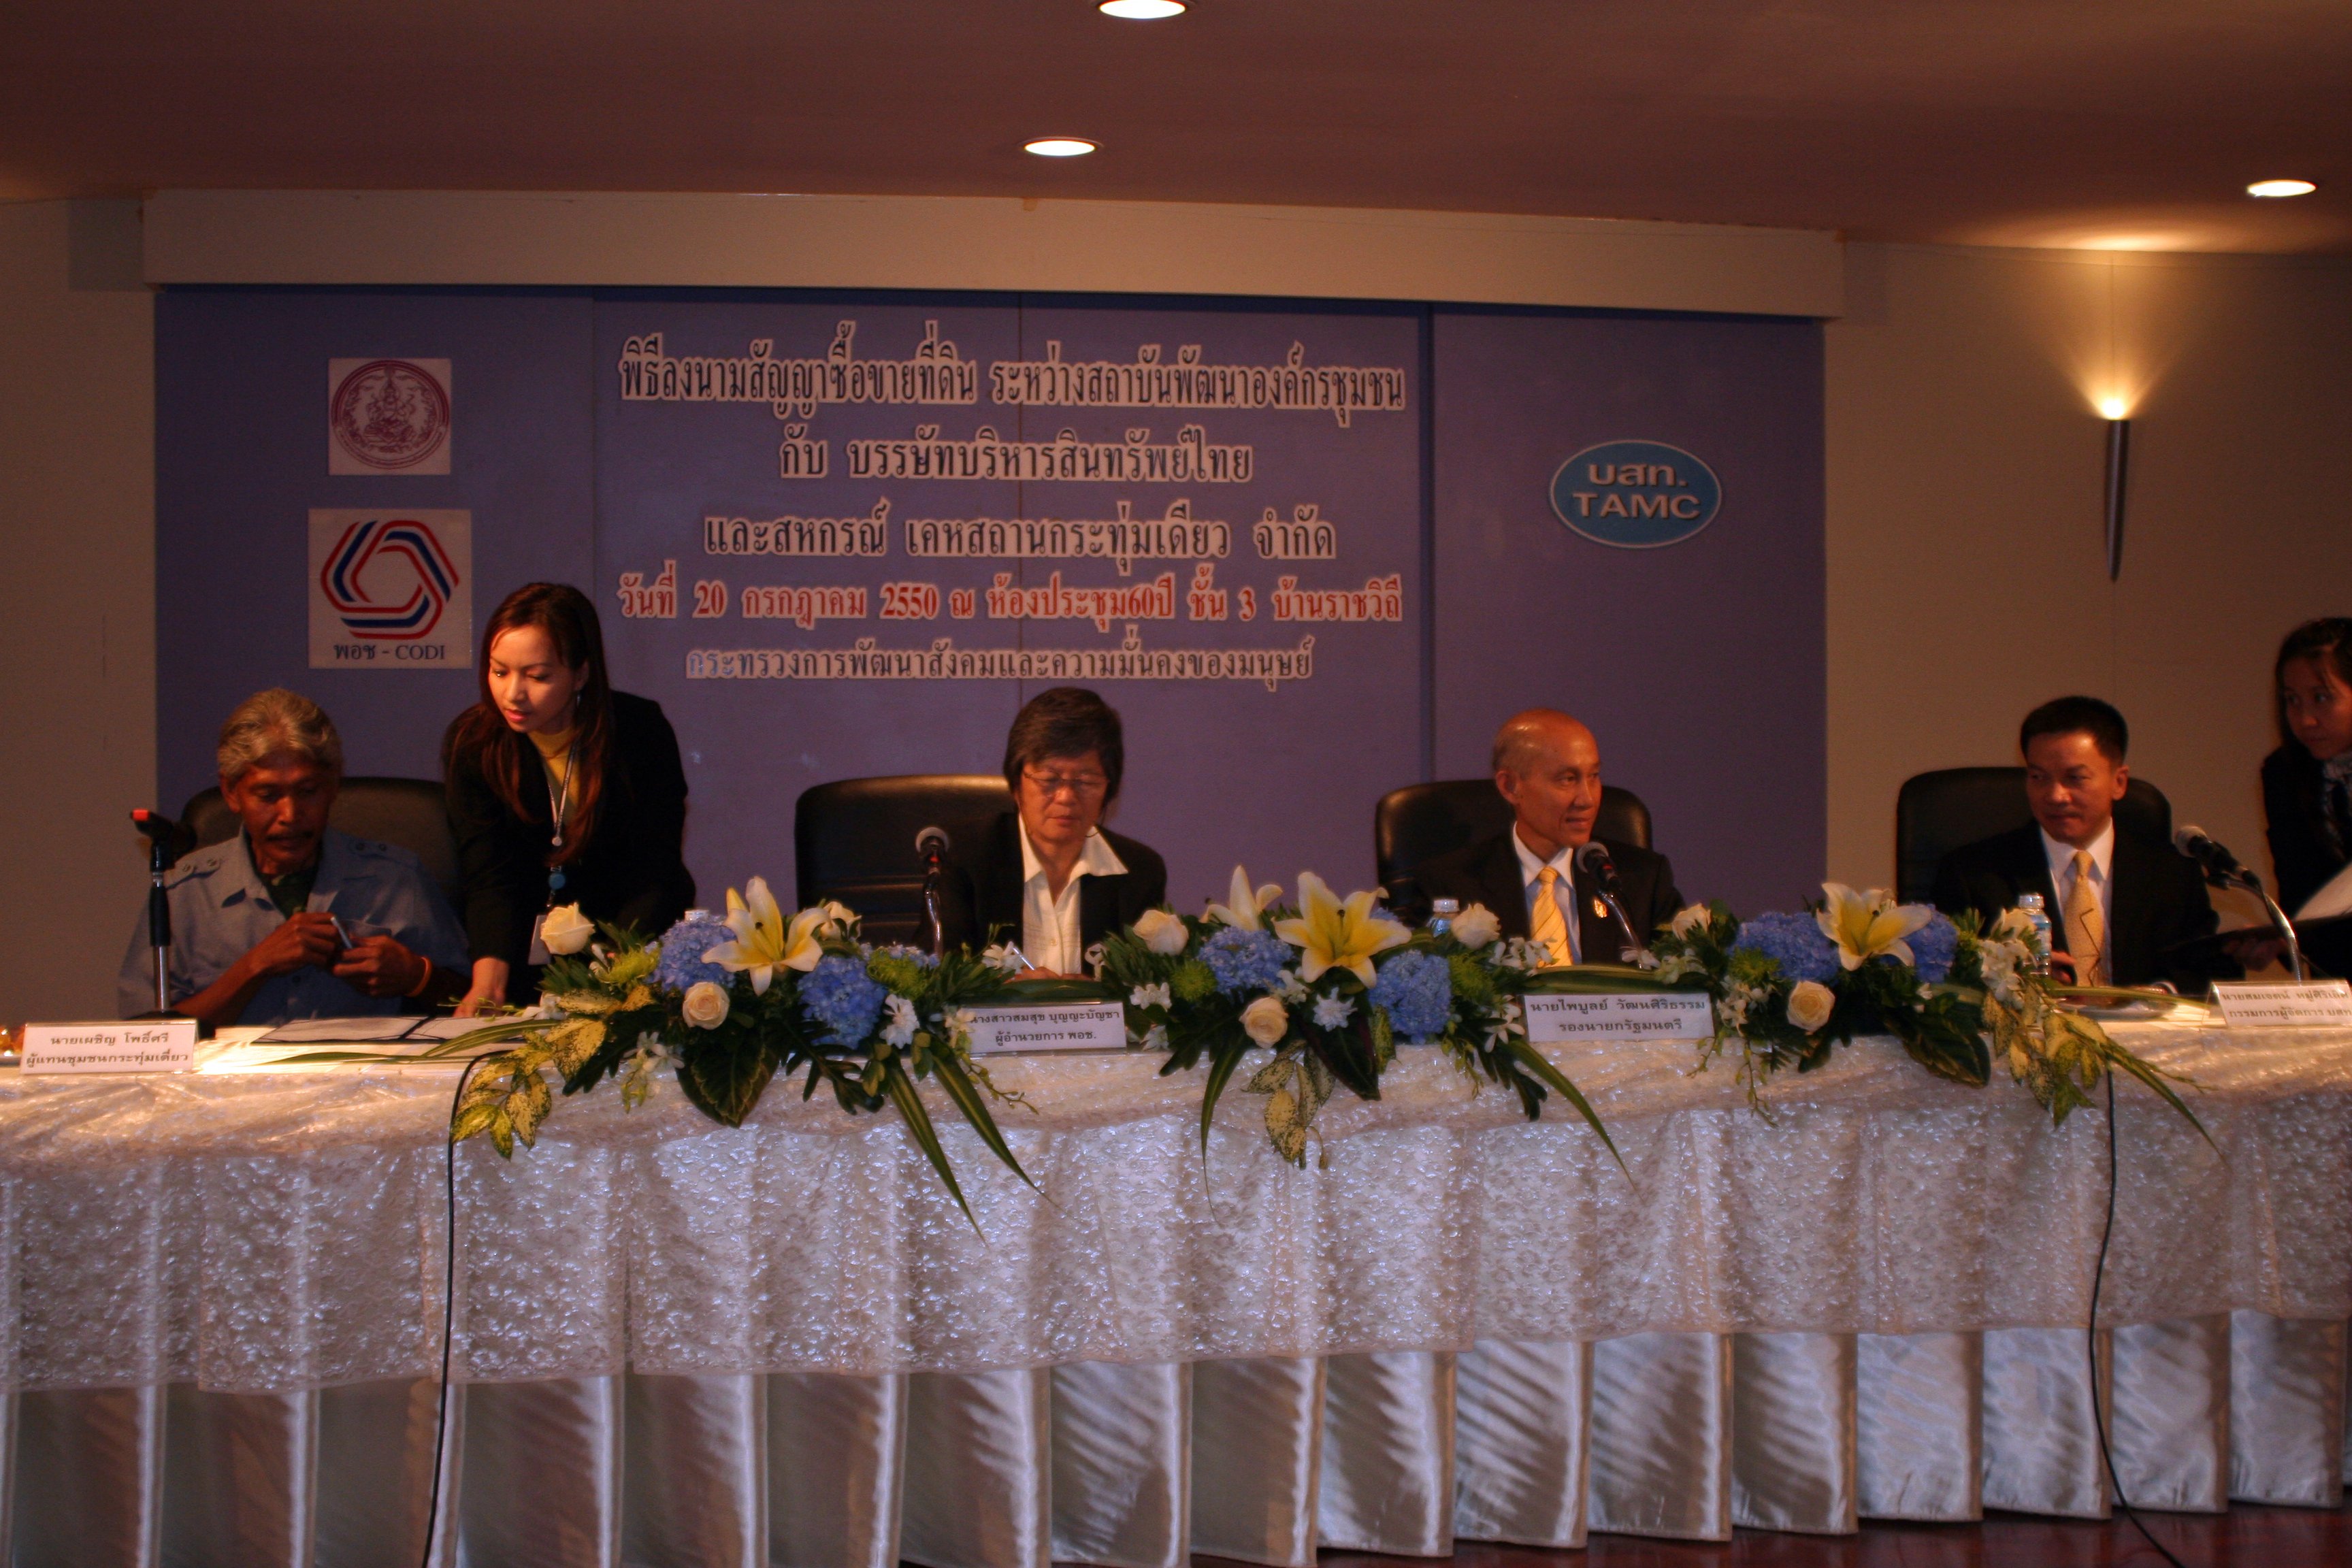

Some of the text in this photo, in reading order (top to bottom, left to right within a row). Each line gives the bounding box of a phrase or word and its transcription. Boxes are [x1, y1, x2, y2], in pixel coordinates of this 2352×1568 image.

[991, 341, 1405, 426] ระหว่างสถาบันพัฒนาองค์กรชุมชน
[781, 425, 1253, 481] กับ บรรษัทบริหารสินทรัพย์ไทย
[1572, 493, 1700, 519] TAMC
[704, 497, 1337, 576] และสหกรณ์ เคหสถานกระทุ่มเดียว จำกัด
[617, 560, 676, 618] วันที่
[692, 581, 727, 617] 20
[742, 587, 866, 630] กรกฎาคม
[879, 583, 938, 618] 2550
[949, 589, 975, 618] ณ
[1188, 562, 1228, 620] ชั้น
[1239, 586, 1256, 621] 3
[1273, 574, 1403, 621] บ้านราชวิถี
[395, 644, 445, 660] CODI
[1530, 998, 1609, 1015] นายไพบูลย์
[995, 1030, 1064, 1047] ผู้อำนวยการ
[1558, 1018, 1683, 1034] รองนายกรัฐมนตรี
